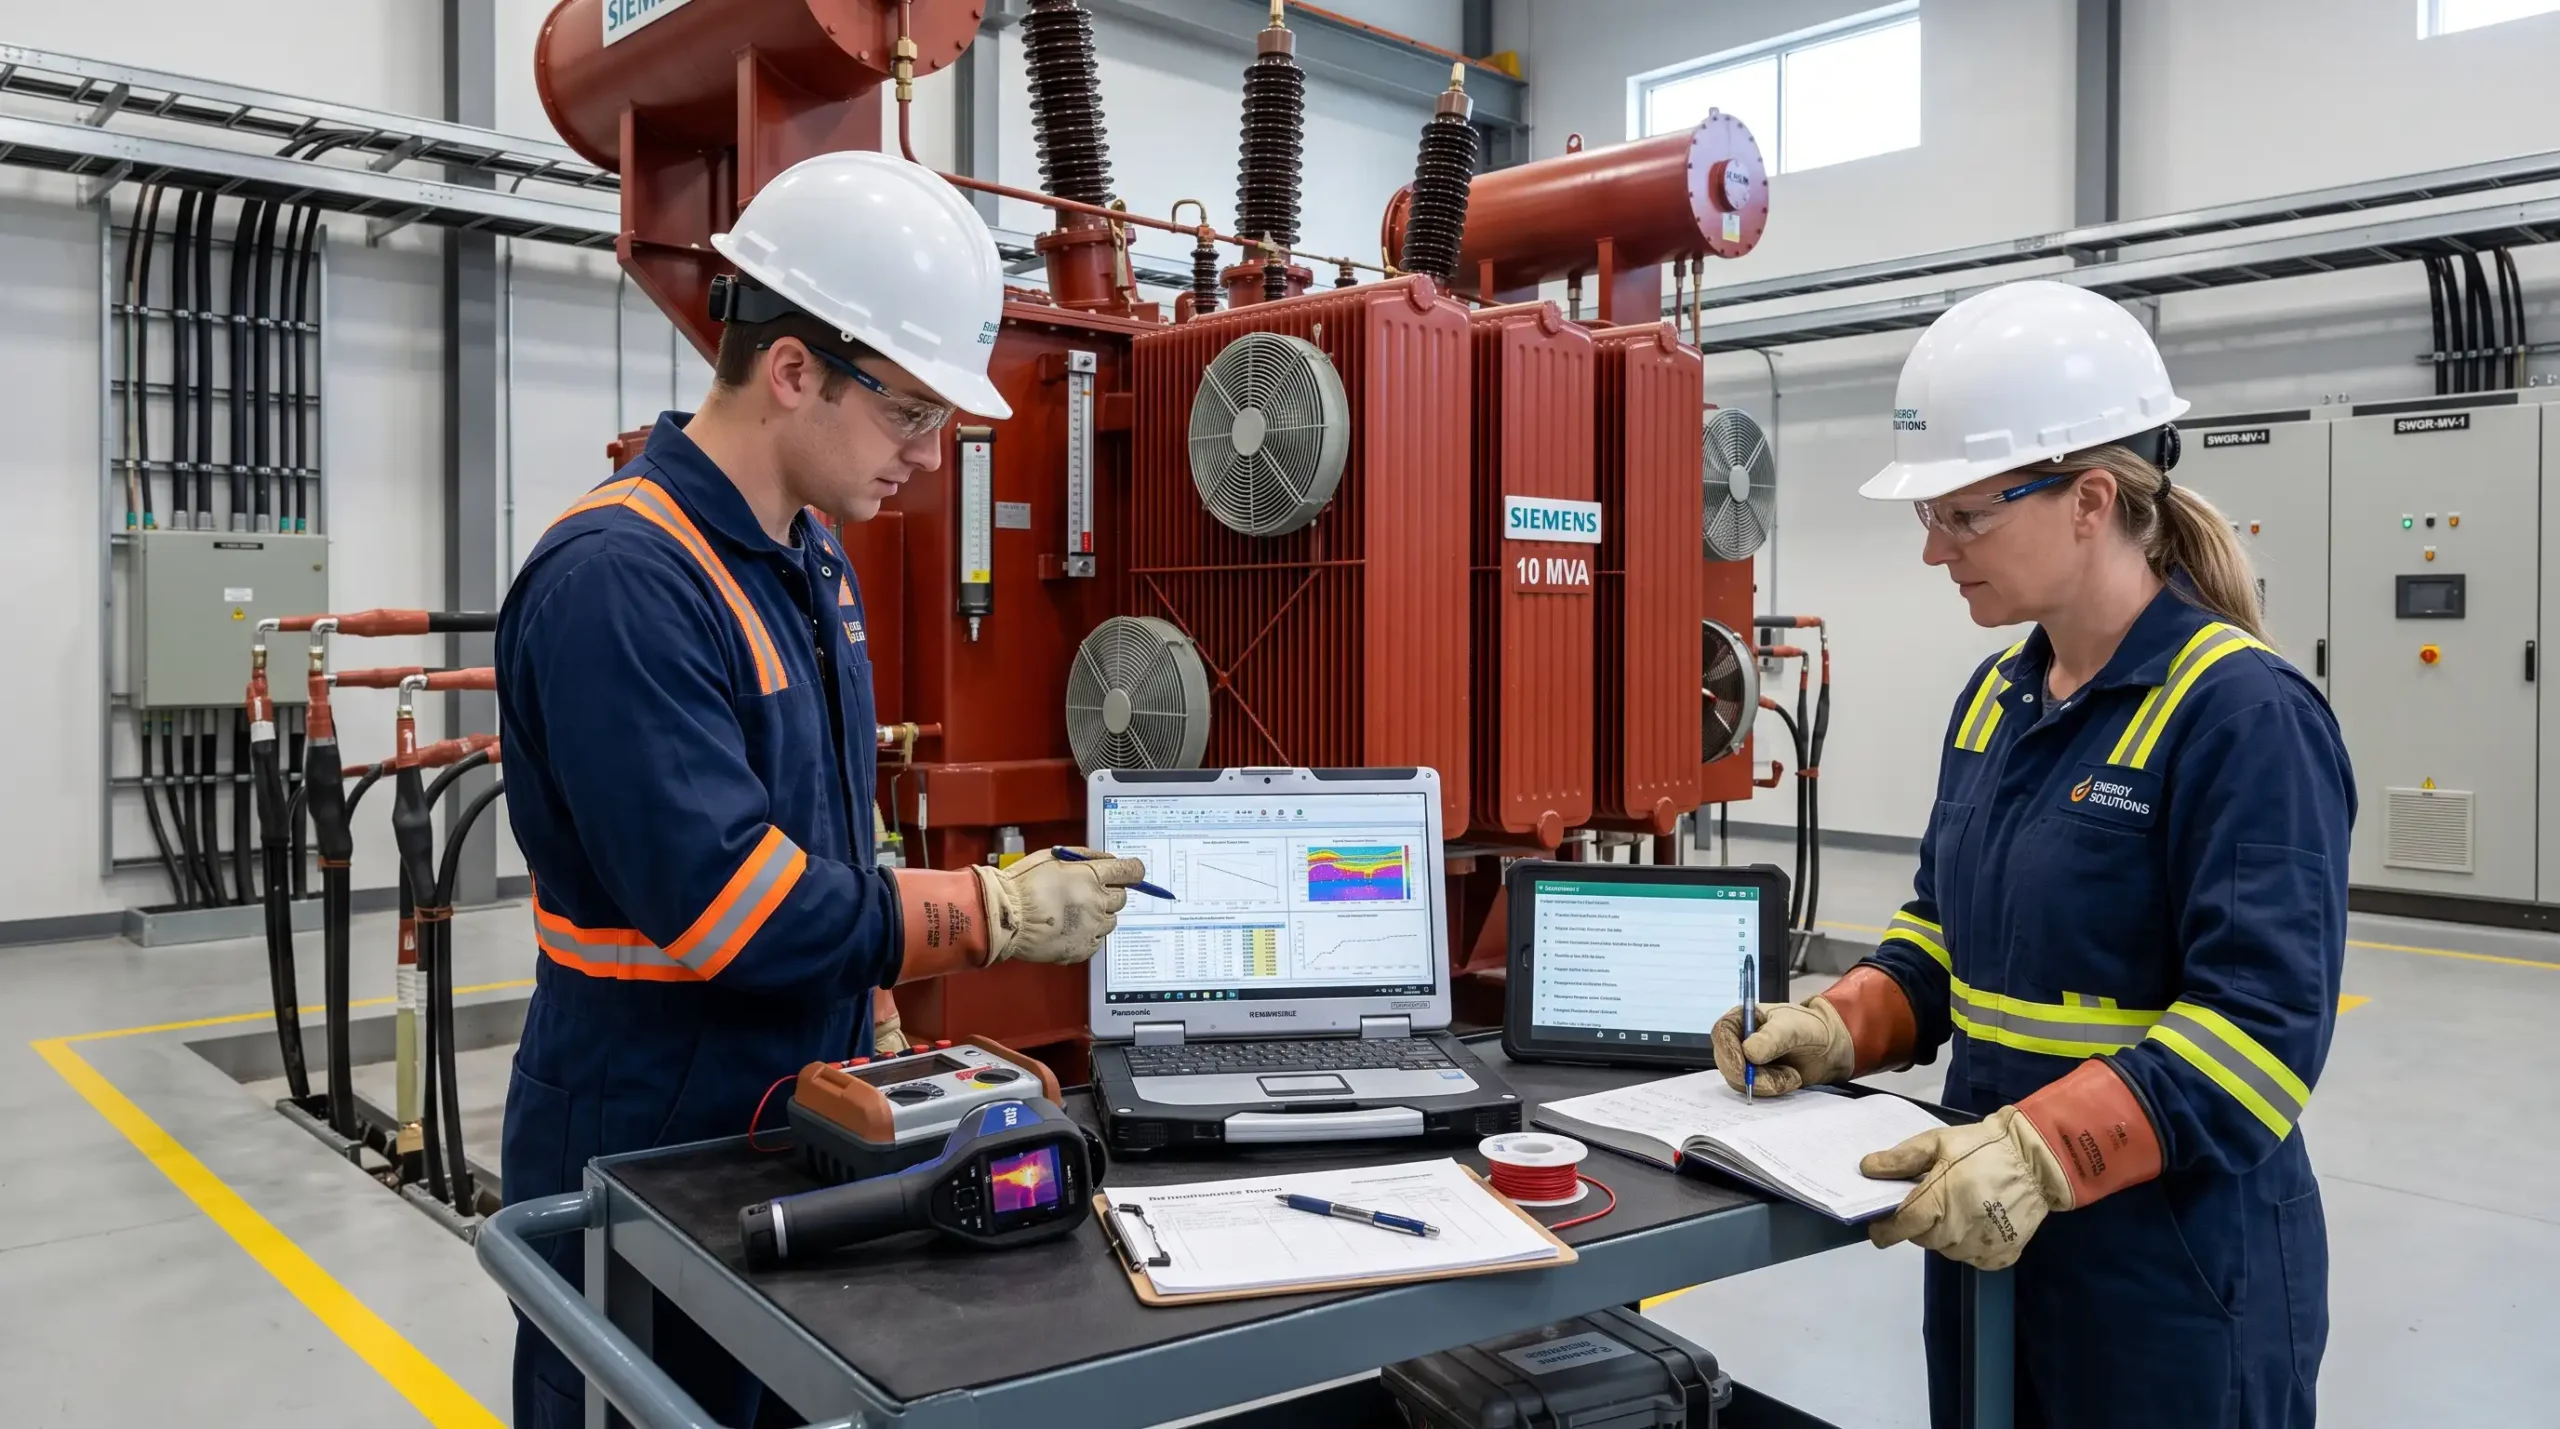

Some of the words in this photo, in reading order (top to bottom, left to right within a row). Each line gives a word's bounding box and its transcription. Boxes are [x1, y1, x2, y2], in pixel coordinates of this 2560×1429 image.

[1511, 507, 1597, 533] SIEMENS
[1517, 557, 1540, 585] 10
[1546, 558, 1590, 586] MVA
[2093, 781, 2133, 798] ENERGY
[2088, 792, 2150, 815] SOLUTIONS
